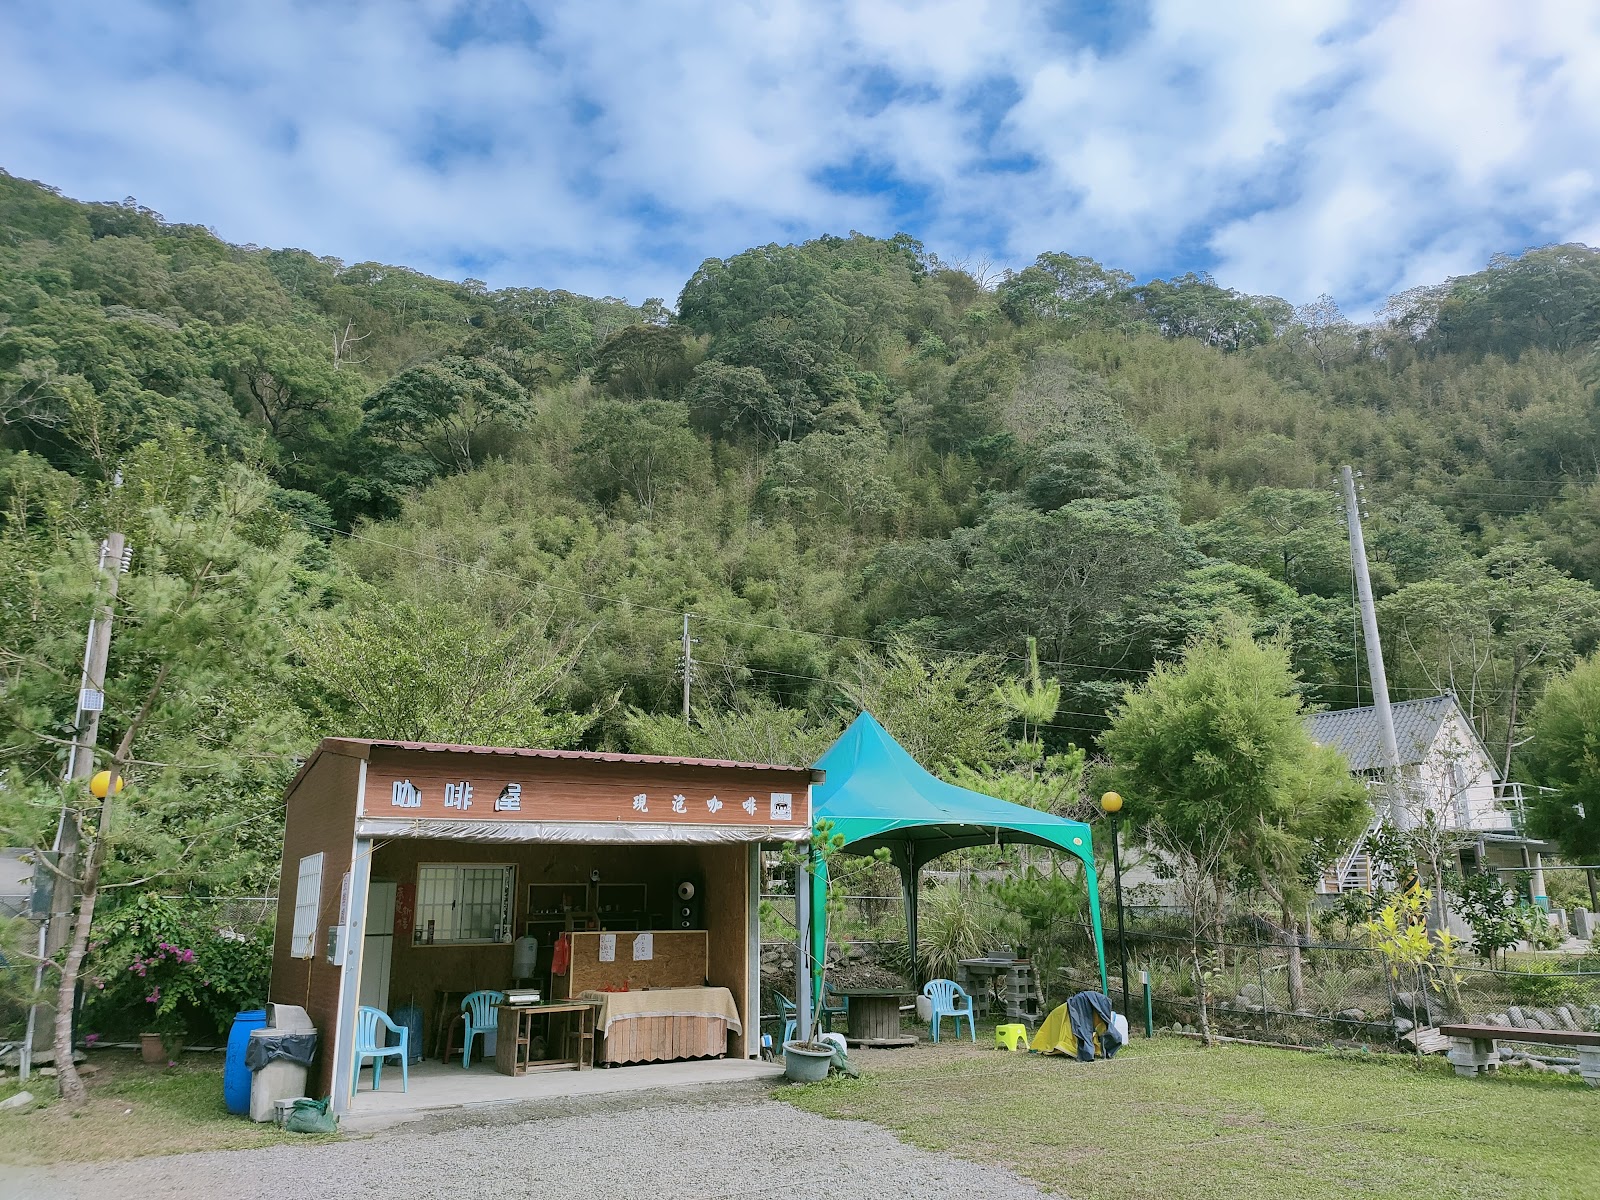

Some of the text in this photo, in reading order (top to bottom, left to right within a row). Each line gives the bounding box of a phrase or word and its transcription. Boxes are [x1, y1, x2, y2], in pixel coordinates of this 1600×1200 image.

[391, 778, 522, 812] 咖啡屋
[632, 793, 758, 817] 現泡咖啡
